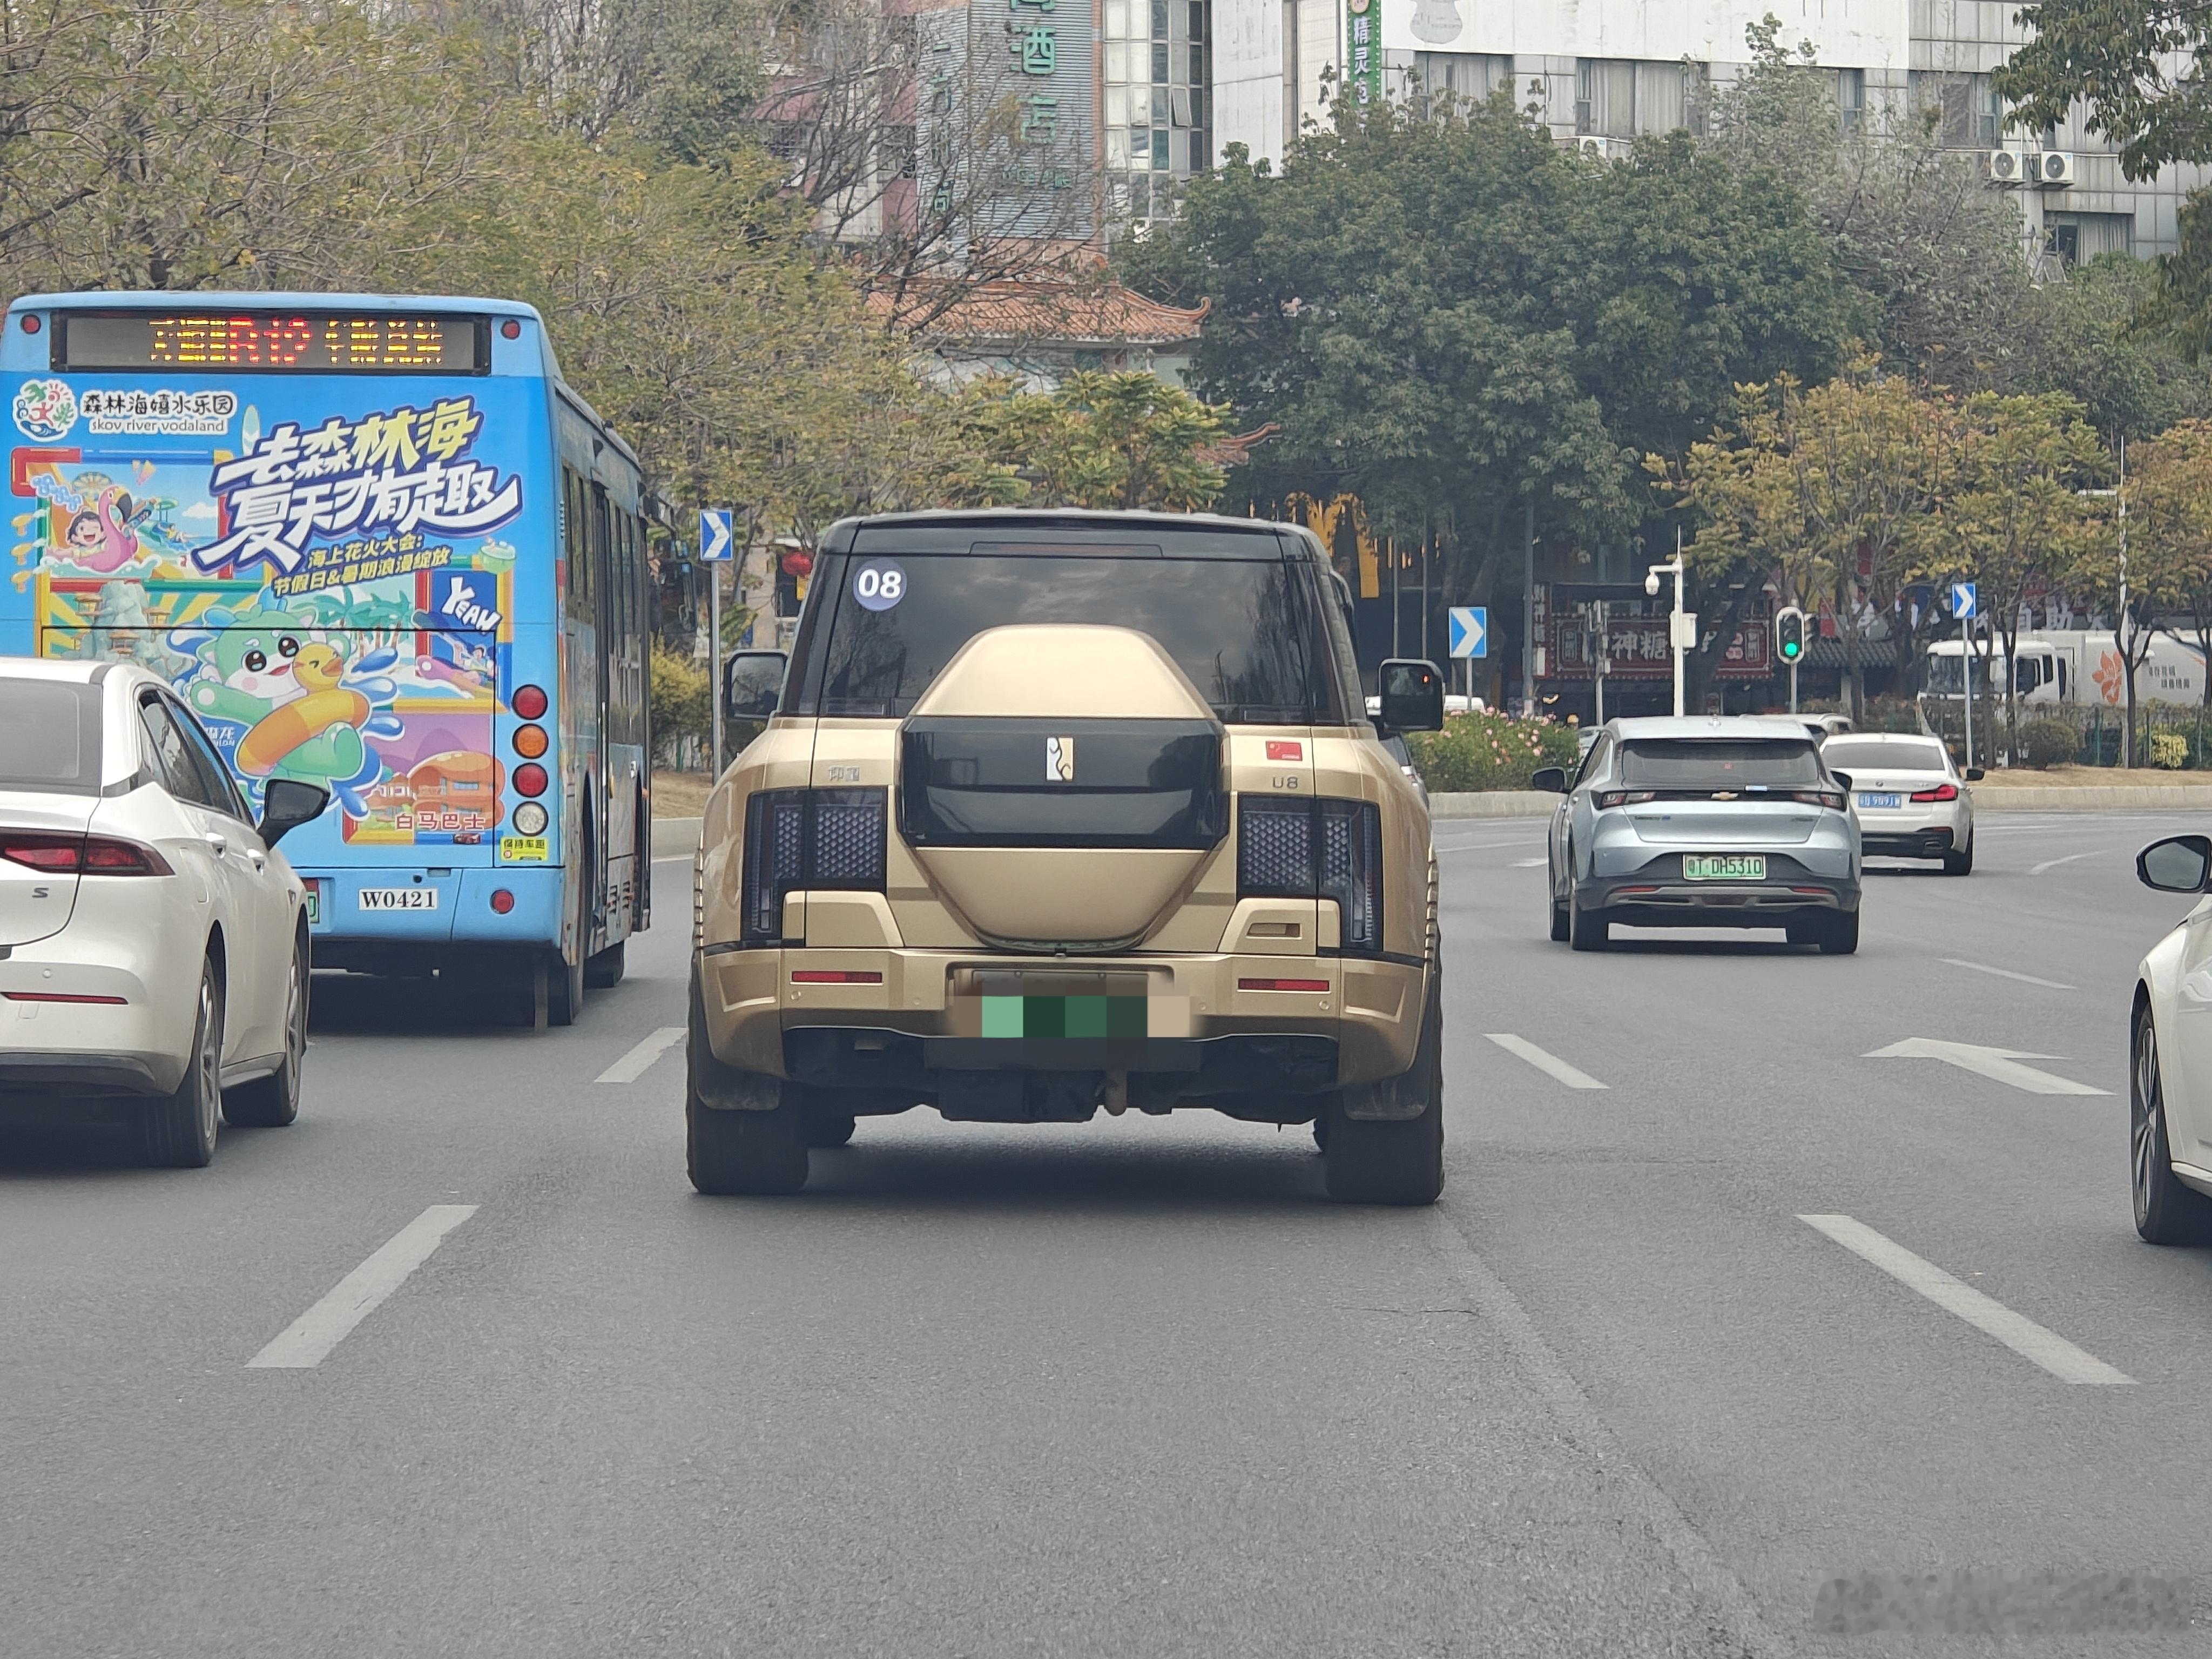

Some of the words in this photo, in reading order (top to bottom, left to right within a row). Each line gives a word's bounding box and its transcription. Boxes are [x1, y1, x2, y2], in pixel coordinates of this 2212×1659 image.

[1010, 0, 1057, 145] 酒店
[83, 394, 233, 415] 森林海嬉水乐园
[92, 419, 122, 431] skov
[126, 419, 157, 431] river
[161, 419, 225, 431] vodaland
[217, 399, 479, 485] 去森林海
[197, 463, 518, 573] 夏天才有趣
[274, 547, 451, 596] 节假日&暑期浪漫绽放
[858, 569, 901, 598] 08
[442, 576, 501, 631] YEAH
[1273, 776, 1298, 788] U8
[396, 812, 485, 830] 白马巴士
[31, 887, 49, 899] S
[362, 891, 435, 908] W0421
